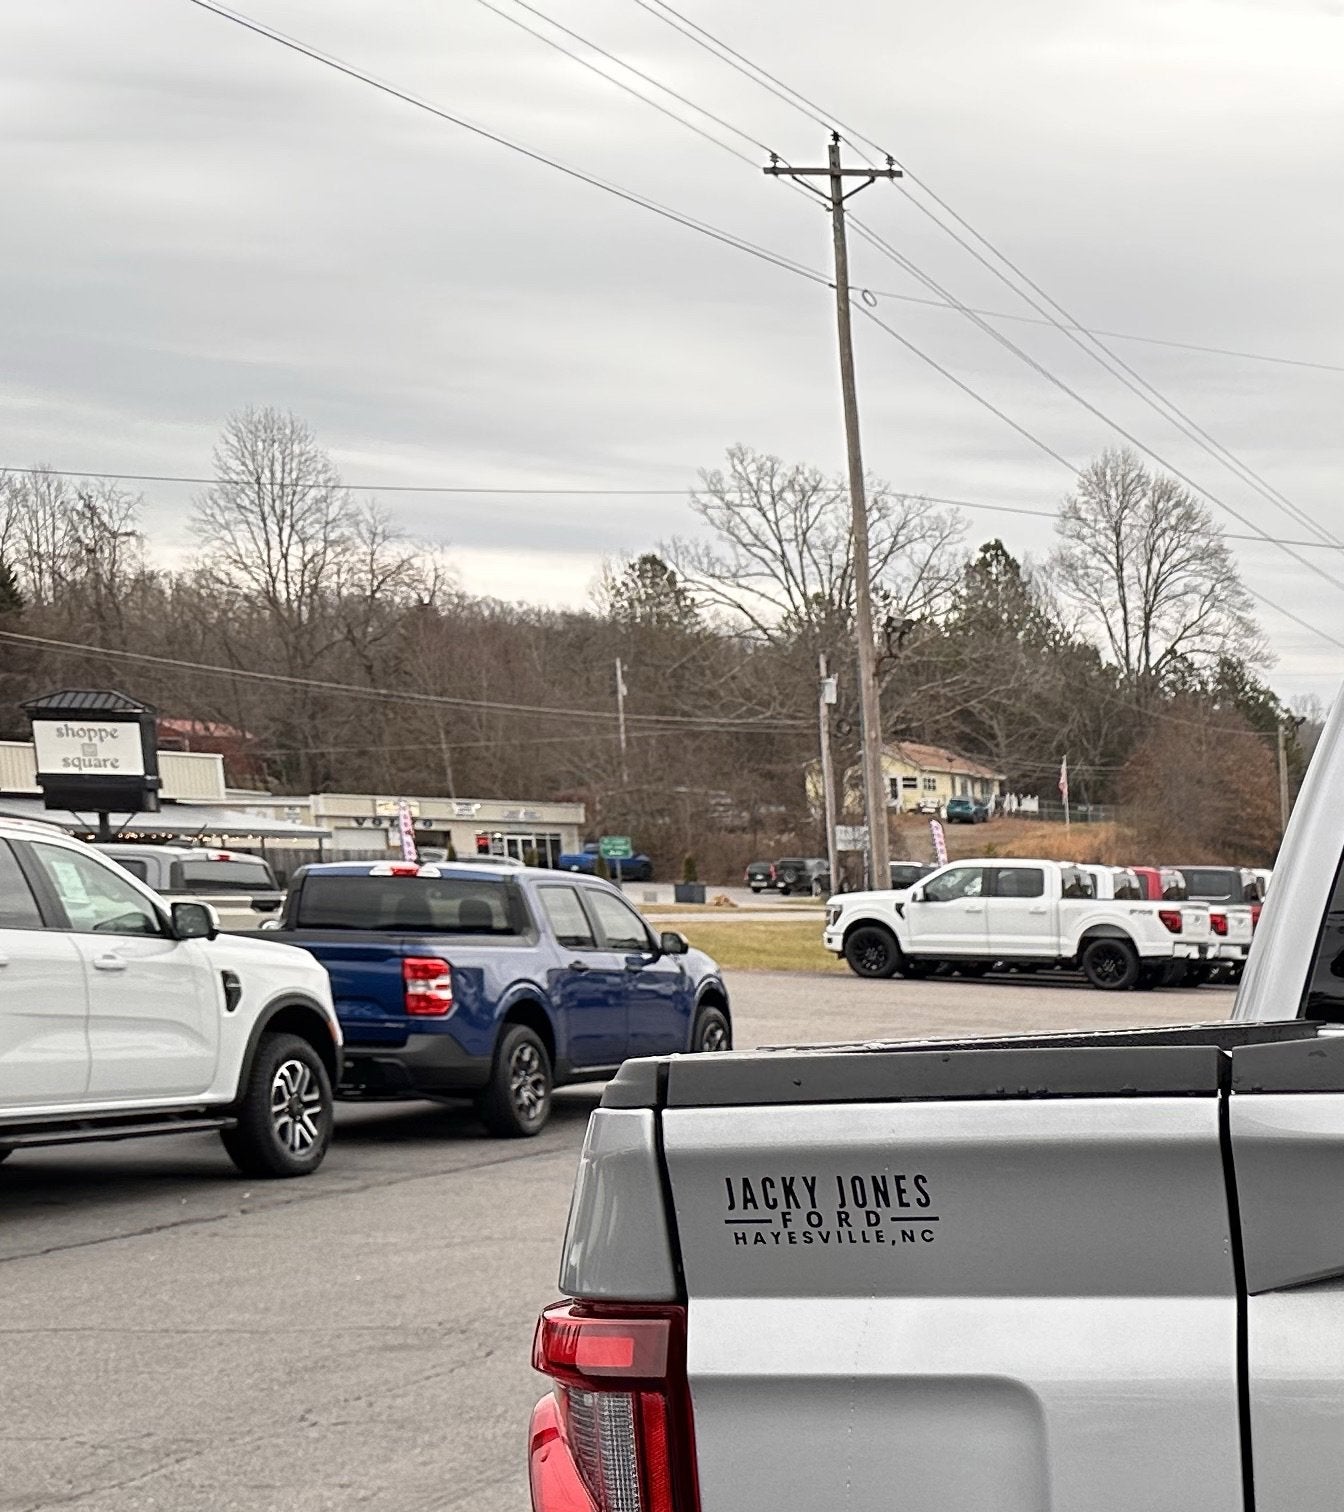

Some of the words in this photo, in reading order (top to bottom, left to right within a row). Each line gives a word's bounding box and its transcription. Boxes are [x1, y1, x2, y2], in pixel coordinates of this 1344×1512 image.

[56, 723, 120, 742] shoppe
[61, 755, 120, 771] square
[724, 1175, 818, 1210] JACKY
[836, 1174, 931, 1208] JONES
[780, 1210, 881, 1229] FORD
